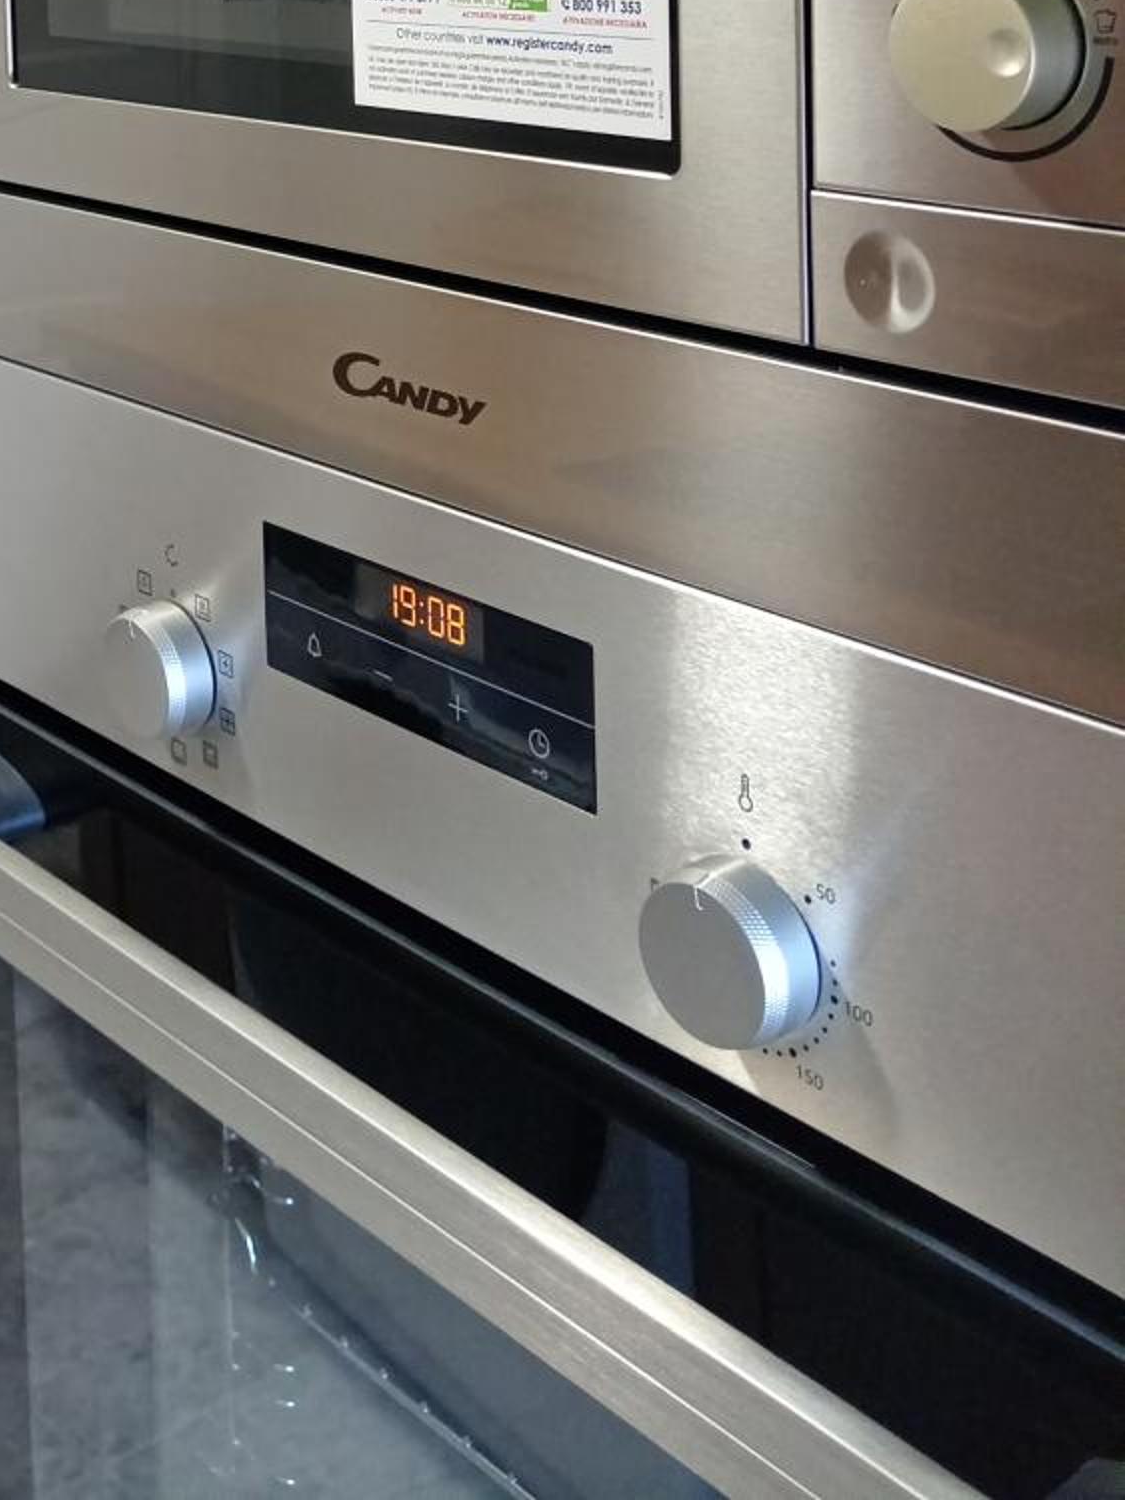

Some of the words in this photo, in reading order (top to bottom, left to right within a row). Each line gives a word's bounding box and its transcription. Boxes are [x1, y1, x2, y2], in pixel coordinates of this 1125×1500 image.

[596, 0, 616, 13] 991
[620, 0, 642, 15] 353
[396, 27, 421, 41] Other
[485, 35, 614, 55] www.registercandy.com
[332, 352, 488, 425] CANDY
[391, 582, 468, 647] 19:08
[815, 883, 836, 905] 50
[843, 1000, 873, 1027] 100
[795, 1063, 824, 1091] 150
